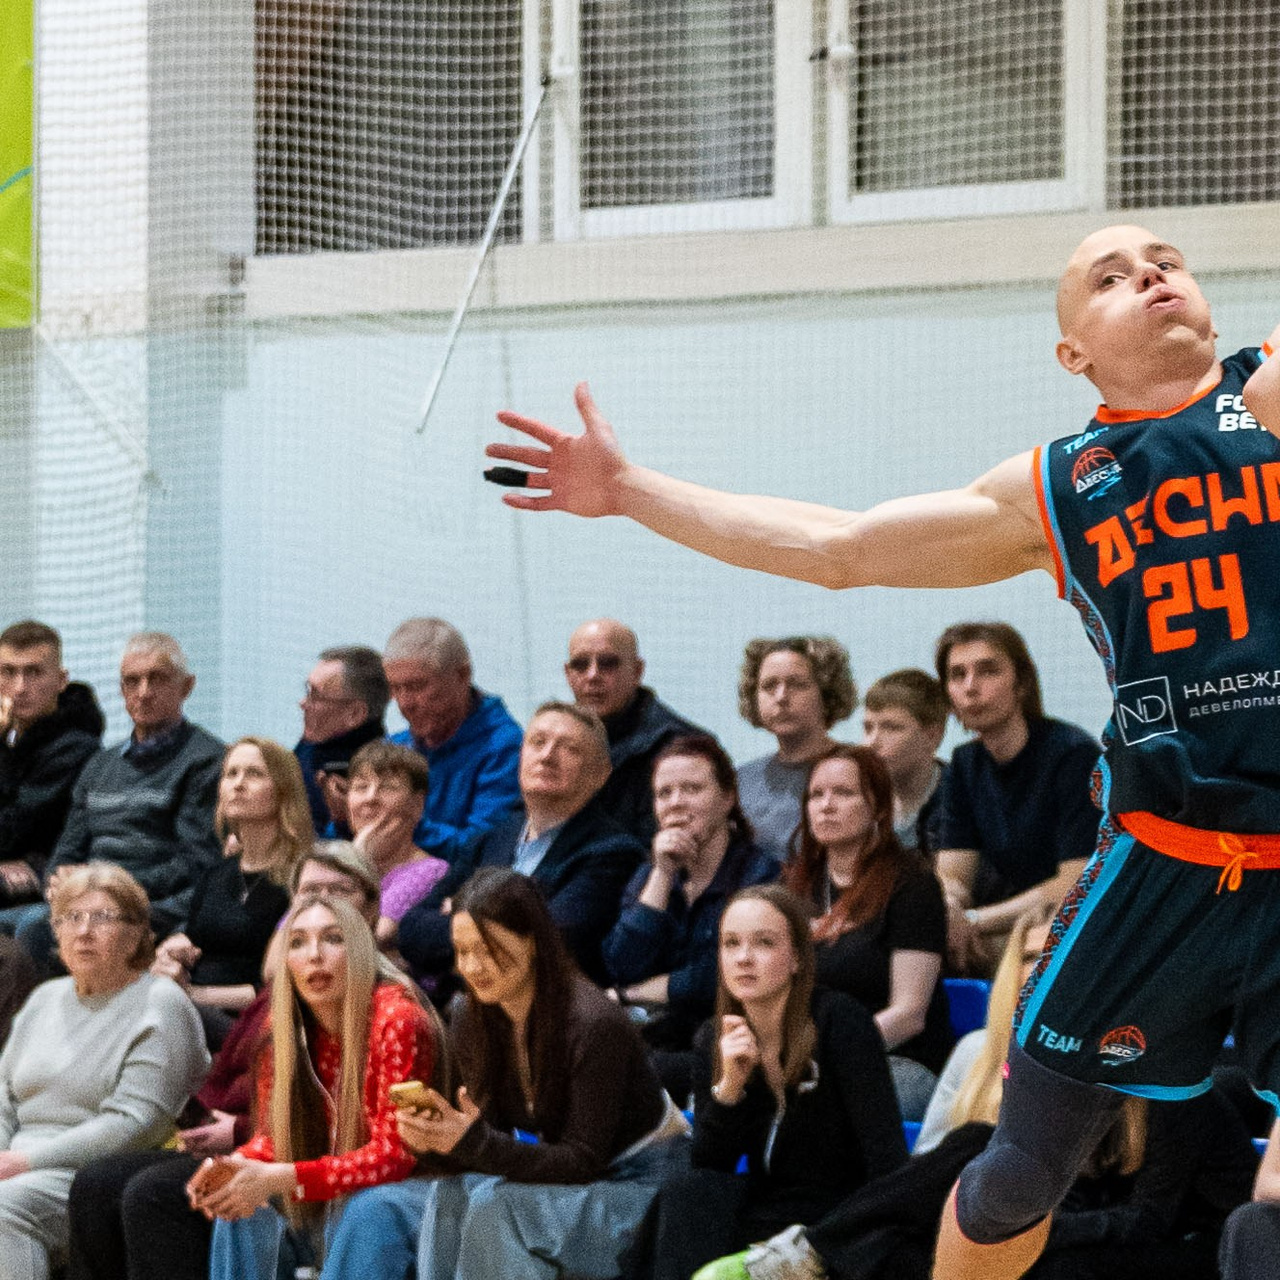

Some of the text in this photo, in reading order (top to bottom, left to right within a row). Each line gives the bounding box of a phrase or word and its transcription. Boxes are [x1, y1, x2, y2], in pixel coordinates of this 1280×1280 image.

[1218, 411, 1268, 432] BE
[1142, 553, 1249, 654] 24
[1038, 1024, 1083, 1053] TEAM
